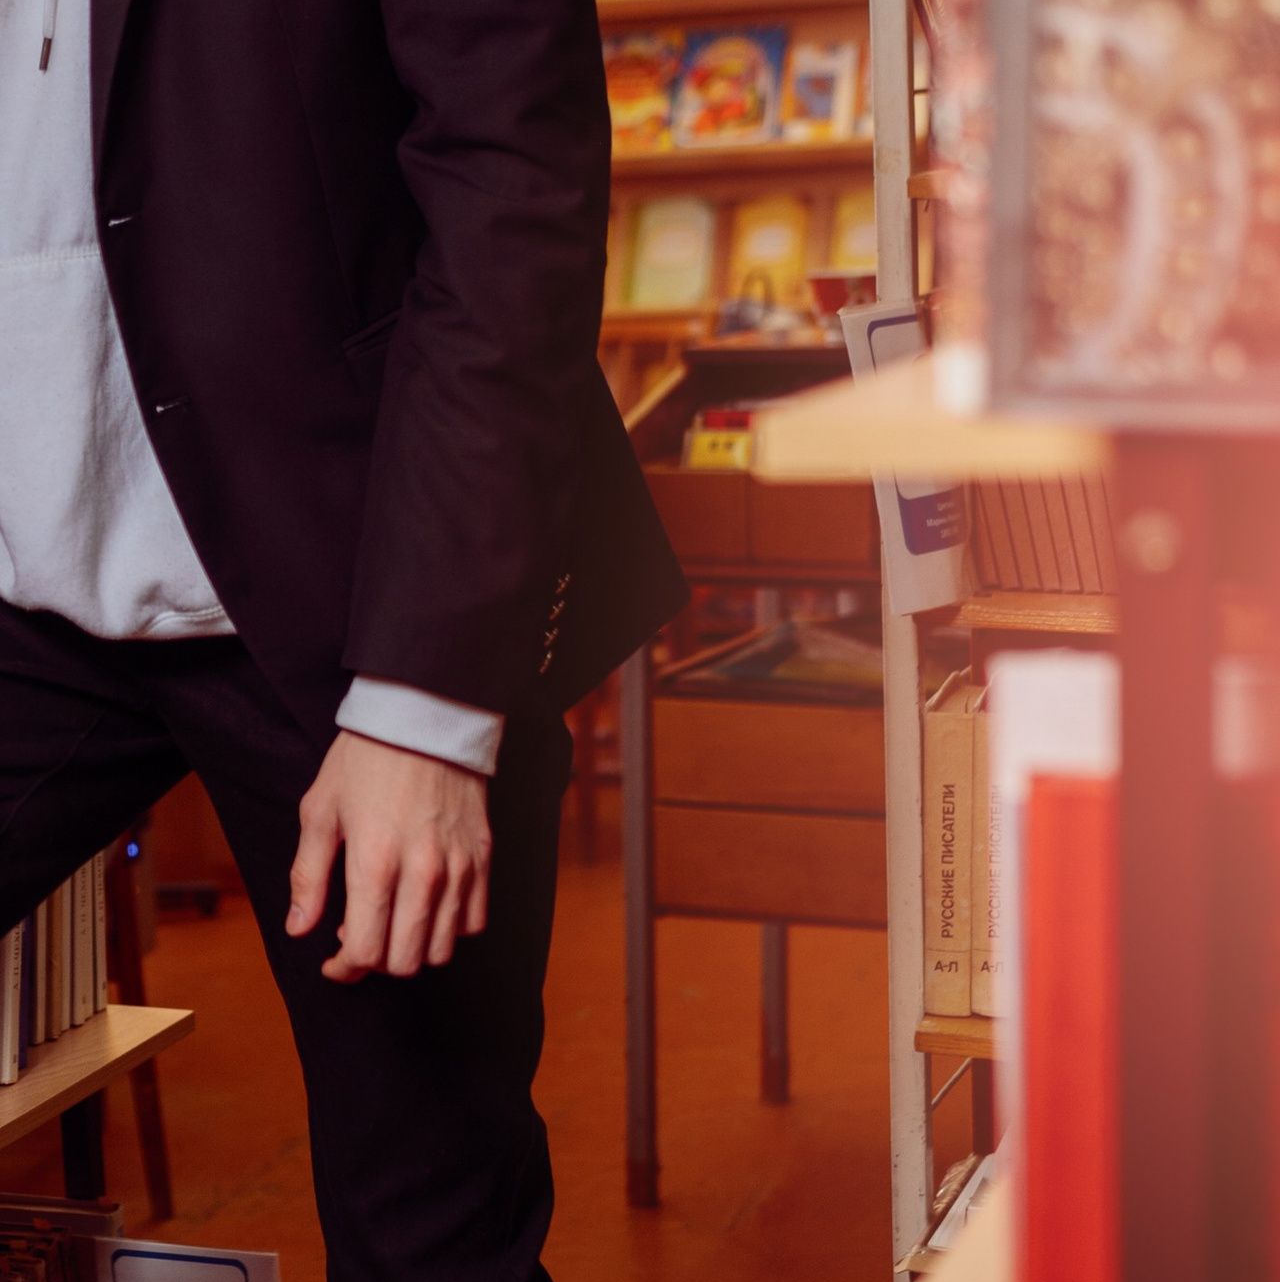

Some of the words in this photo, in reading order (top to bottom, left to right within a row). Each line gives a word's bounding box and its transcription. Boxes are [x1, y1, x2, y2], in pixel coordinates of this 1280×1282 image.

[940, 783, 956, 865] ПИСАТЕЛИ
[941, 869, 955, 939] РУССКИЕ
[934, 960, 959, 973] А-Л
